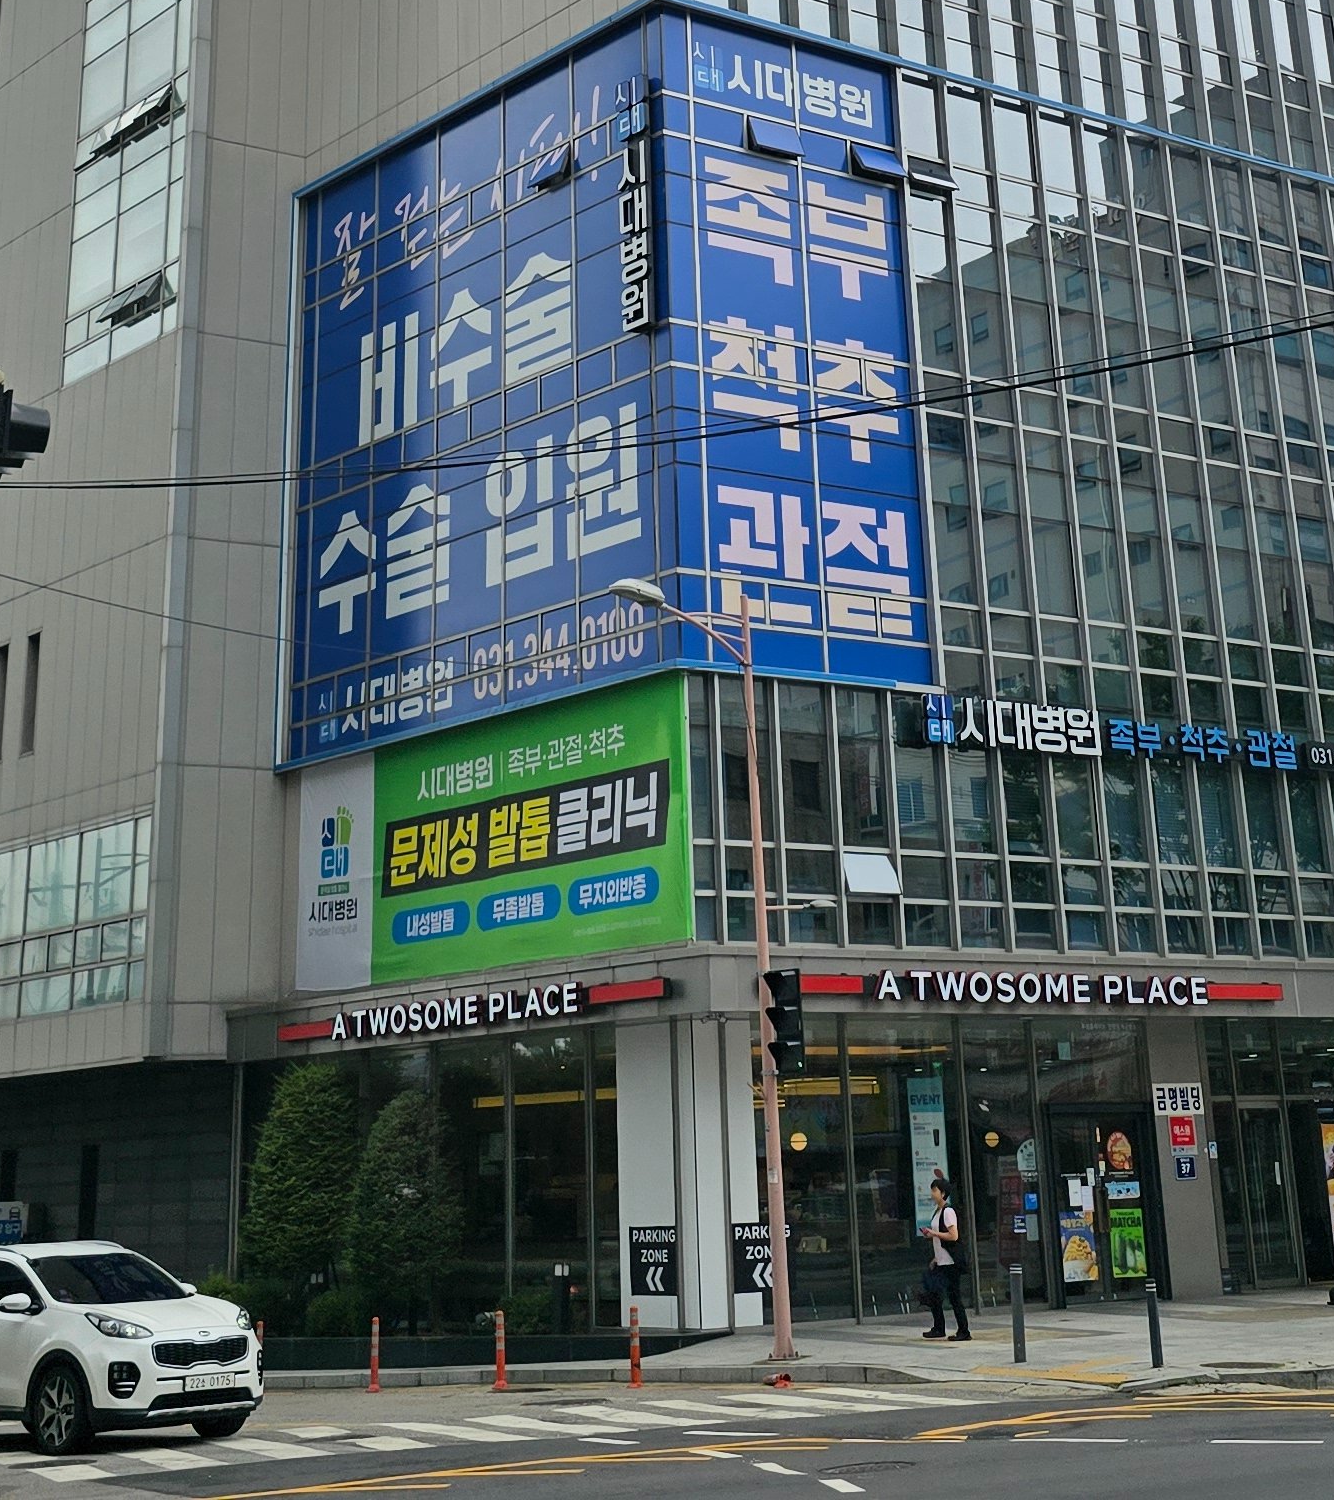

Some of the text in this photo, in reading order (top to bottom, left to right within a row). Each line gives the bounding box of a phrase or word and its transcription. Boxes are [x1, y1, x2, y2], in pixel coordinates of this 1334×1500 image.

[727, 52, 873, 130] 시대병원
[616, 140, 651, 333] 시대병원
[704, 155, 890, 301] 족부
[356, 250, 573, 449] 비수술
[708, 315, 899, 463] 척추
[317, 403, 643, 636] 수술 입원
[716, 483, 914, 637] 관절
[341, 655, 454, 735] 시대병원
[472, 600, 645, 700] 031.344.0100
[959, 697, 1103, 757] 시대병원
[417, 753, 494, 801] 시대병원
[390, 771, 658, 888] 문제성 발톱 클리닉
[492, 891, 545, 922] 무좀발톱
[578, 873, 647, 908] 무지외반증
[308, 897, 358, 923] 시대병원
[406, 908, 455, 938] 내성발톱
[876, 970, 1210, 1006] A TWOSOME PLACE
[331, 981, 579, 1041] A TWOSOME PLACE
[910, 1094, 941, 1106] EVENT
[1155, 1086, 1201, 1111] 금명빌딩
[1180, 1163, 1191, 1174] 37
[4, 1223, 21, 1235] 입구
[632, 1229, 676, 1243] PARKING
[734, 1224, 791, 1240] PARKG
[1110, 1217, 1142, 1229] MATCHA
[640, 1249, 669, 1263] ZONE
[745, 1245, 773, 1260] ZON
[209, 1374, 231, 1387] 0175
